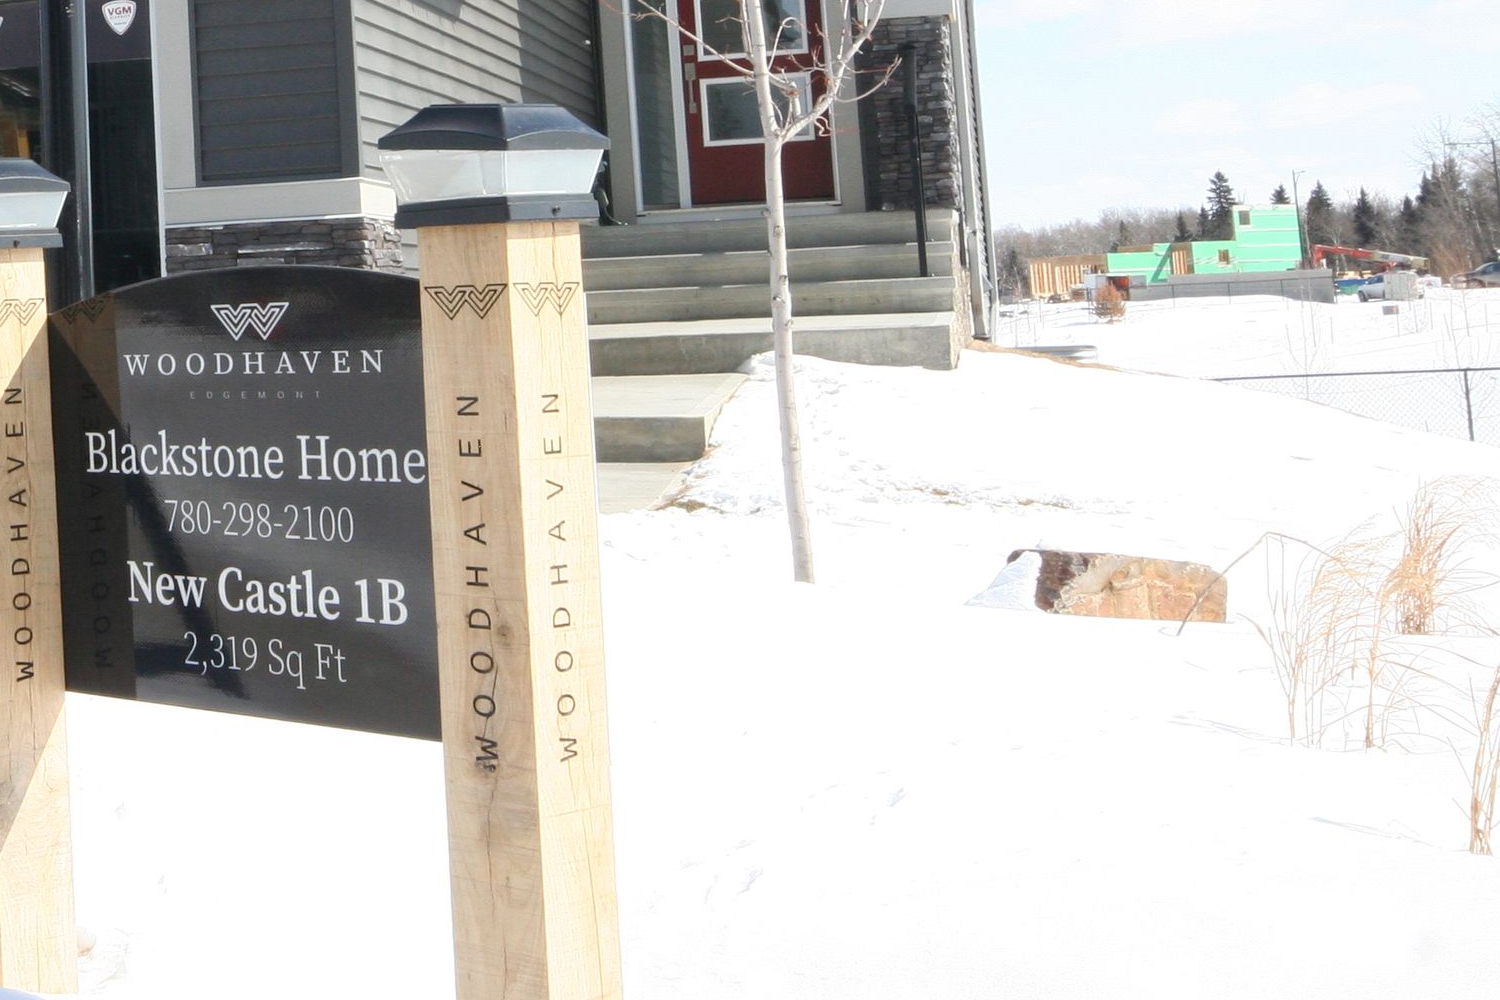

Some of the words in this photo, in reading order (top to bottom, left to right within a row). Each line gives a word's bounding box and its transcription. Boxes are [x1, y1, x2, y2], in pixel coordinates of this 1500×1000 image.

[107, 6, 132, 16] VGM
[124, 349, 384, 376] WOODHAVEN
[190, 390, 321, 400] EDGEMONT
[85, 429, 285, 480] Blackstone
[4, 387, 36, 683] WOODHAVEN
[164, 499, 355, 543] 780-298-2100
[126, 560, 207, 609] New
[218, 567, 341, 620] Castle
[355, 578, 408, 626] 1B
[457, 395, 500, 772] WOODHAVEN
[541, 393, 578, 763] WOODHAVEN
[183, 631, 259, 676] 2,319
[268, 638, 306, 690] Sq
[314, 643, 348, 683] Ft
